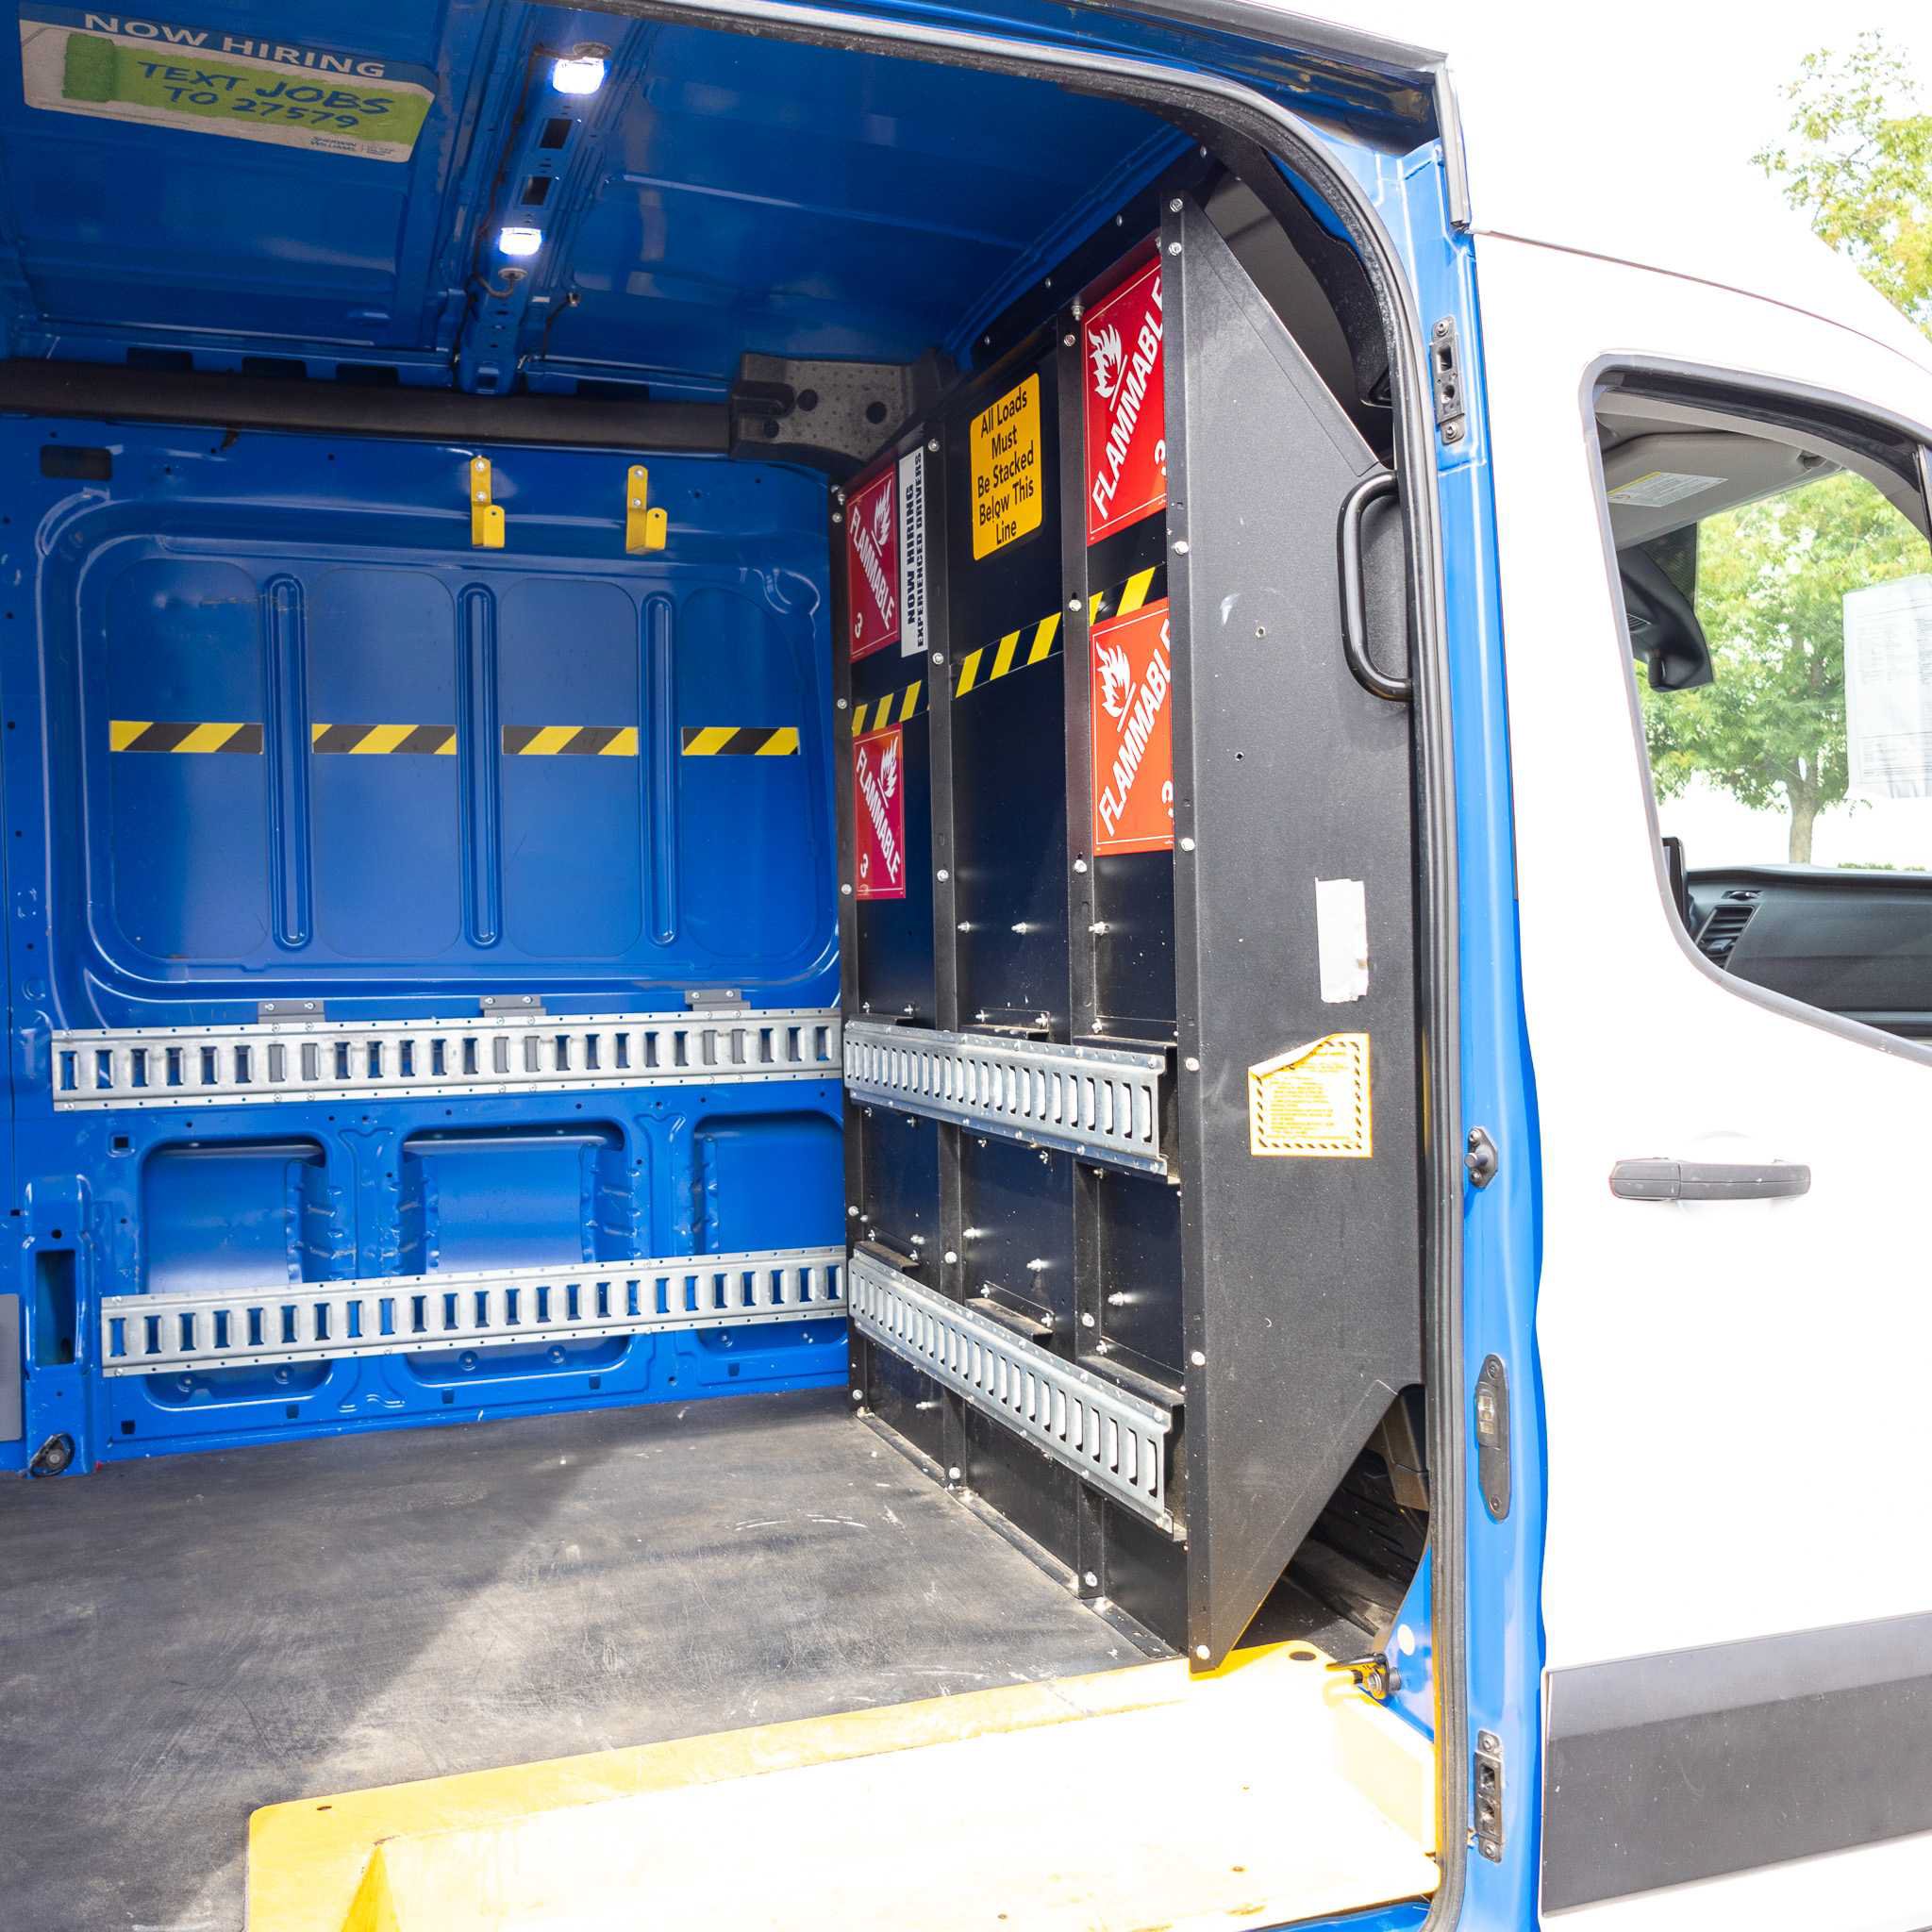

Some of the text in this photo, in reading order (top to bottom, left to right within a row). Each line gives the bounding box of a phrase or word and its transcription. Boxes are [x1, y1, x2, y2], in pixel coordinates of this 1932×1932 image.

[85, 13, 385, 77] NOW HIRING
[136, 61, 393, 115] TEXT JOBS
[163, 85, 358, 128] TO 27579
[981, 387, 1027, 438] All Loads
[978, 440, 1034, 498] Be Stacked
[991, 425, 1017, 459] Must
[979, 475, 1034, 527] Below This
[906, 484, 915, 625] NOW HIRING
[914, 452, 924, 646] EXPERIENCED DRIVERS
[996, 520, 1017, 544] Line
[850, 505, 894, 630] FLAMMABLE
[855, 613, 862, 639] 3
[857, 747, 900, 883] FLAMMABLE
